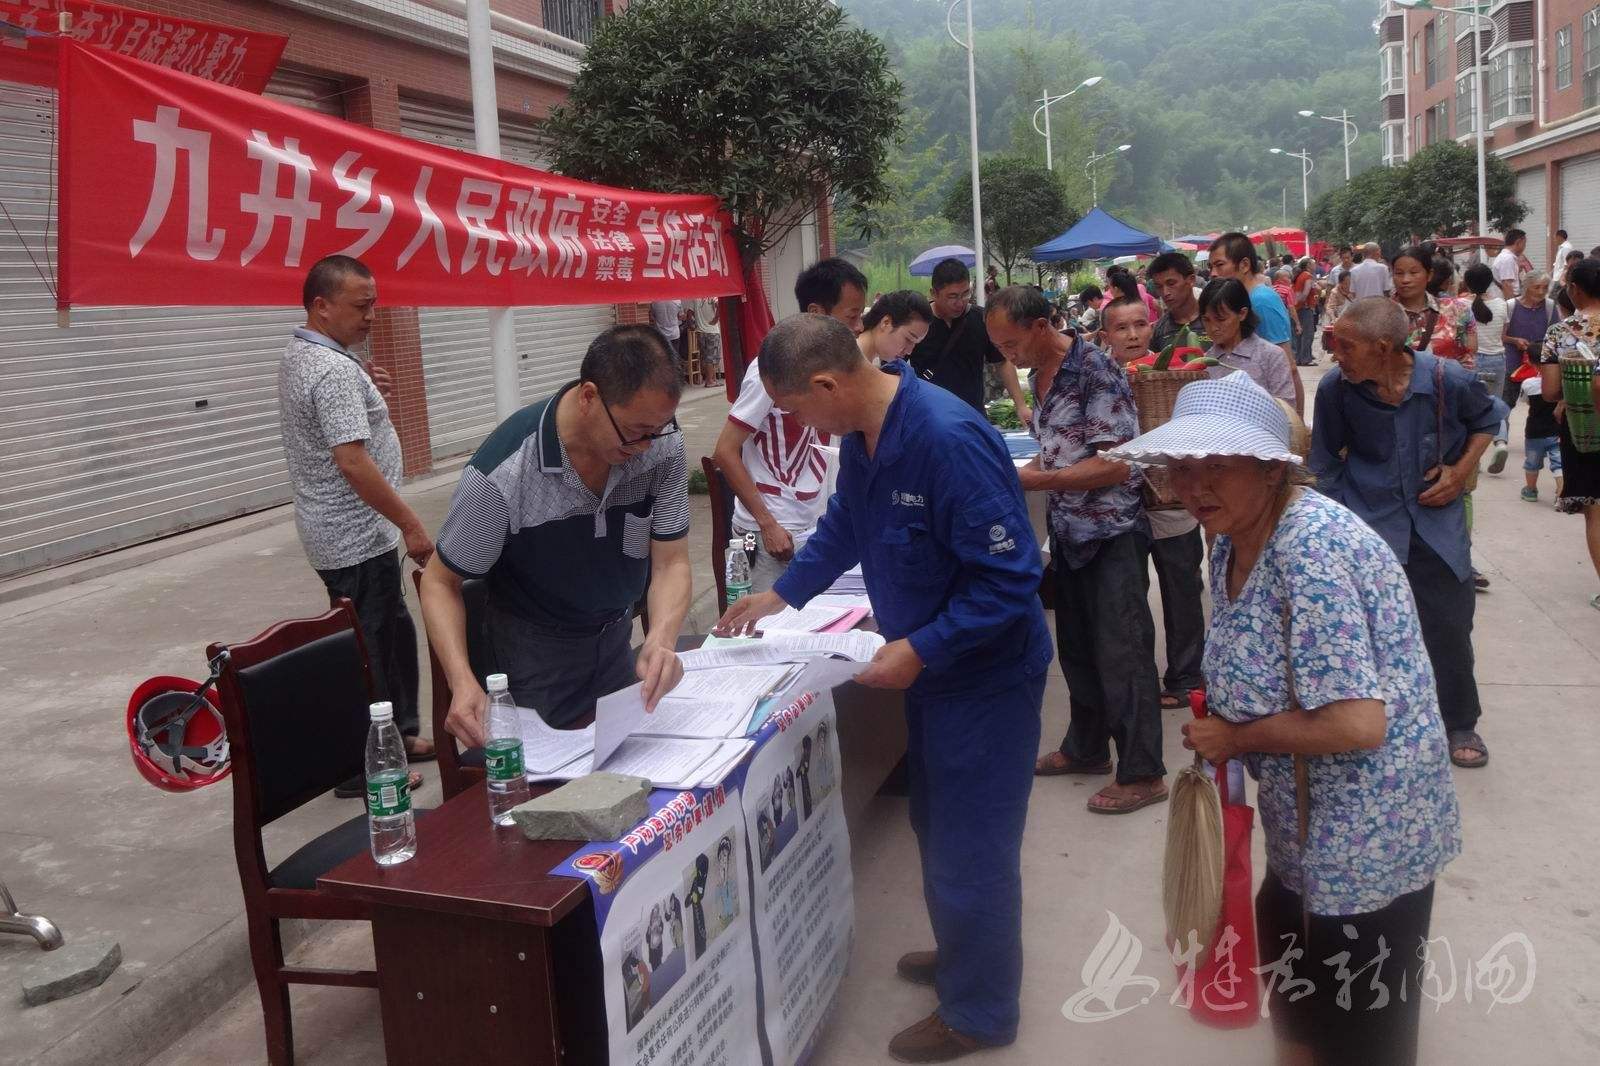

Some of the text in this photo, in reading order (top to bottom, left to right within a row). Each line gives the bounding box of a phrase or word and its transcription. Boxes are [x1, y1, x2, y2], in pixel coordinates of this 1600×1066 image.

[129, 106, 588, 280] 九井乡人民政府
[589, 198, 631, 225] 安全
[587, 228, 636, 253] 法律
[637, 207, 729, 280] 宣传活动
[595, 255, 634, 282] 禁毒
